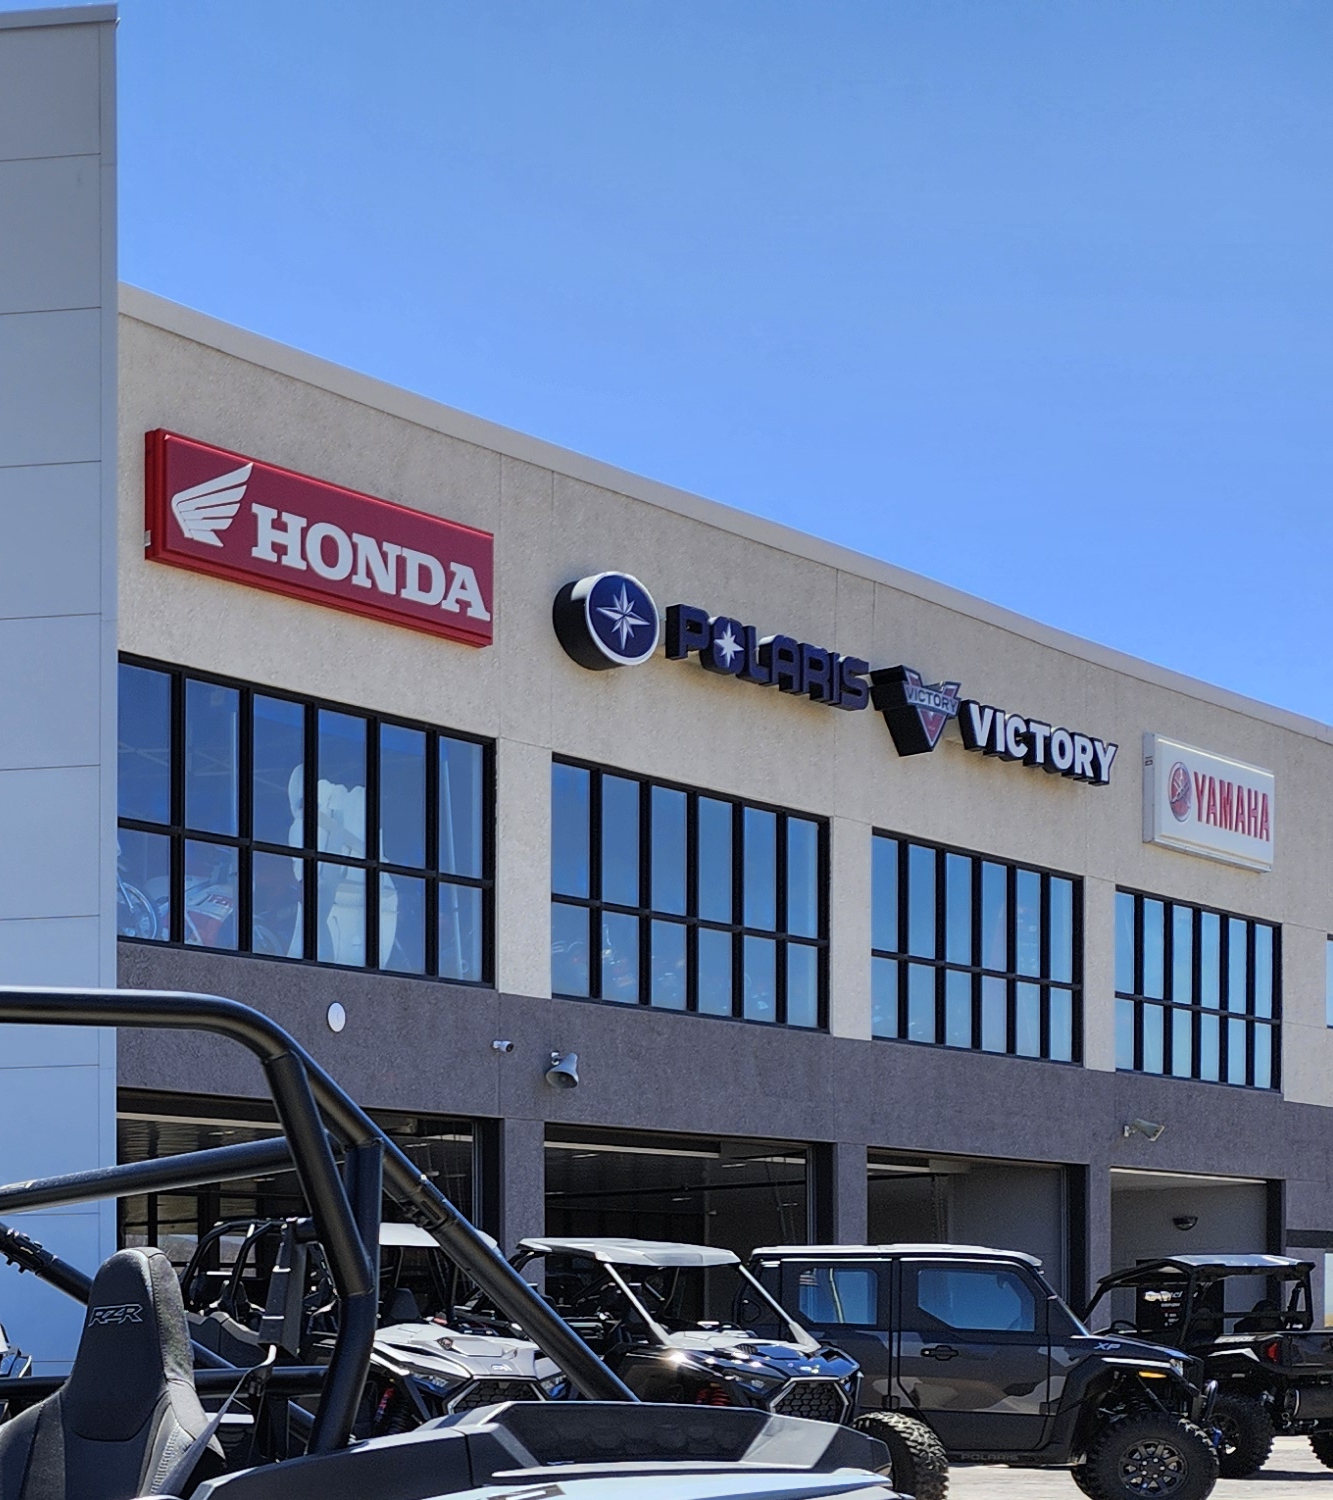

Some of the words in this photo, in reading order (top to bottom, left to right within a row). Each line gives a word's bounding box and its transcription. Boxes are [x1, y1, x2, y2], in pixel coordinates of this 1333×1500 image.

[250, 502, 492, 622] HONDA
[665, 603, 871, 712] POLARIS
[906, 686, 958, 712] VICTORY
[963, 699, 1119, 786] VICTORY
[1193, 770, 1271, 842] YAMAHA
[87, 1303, 145, 1328] RZR
[1093, 1341, 1121, 1351] XP
